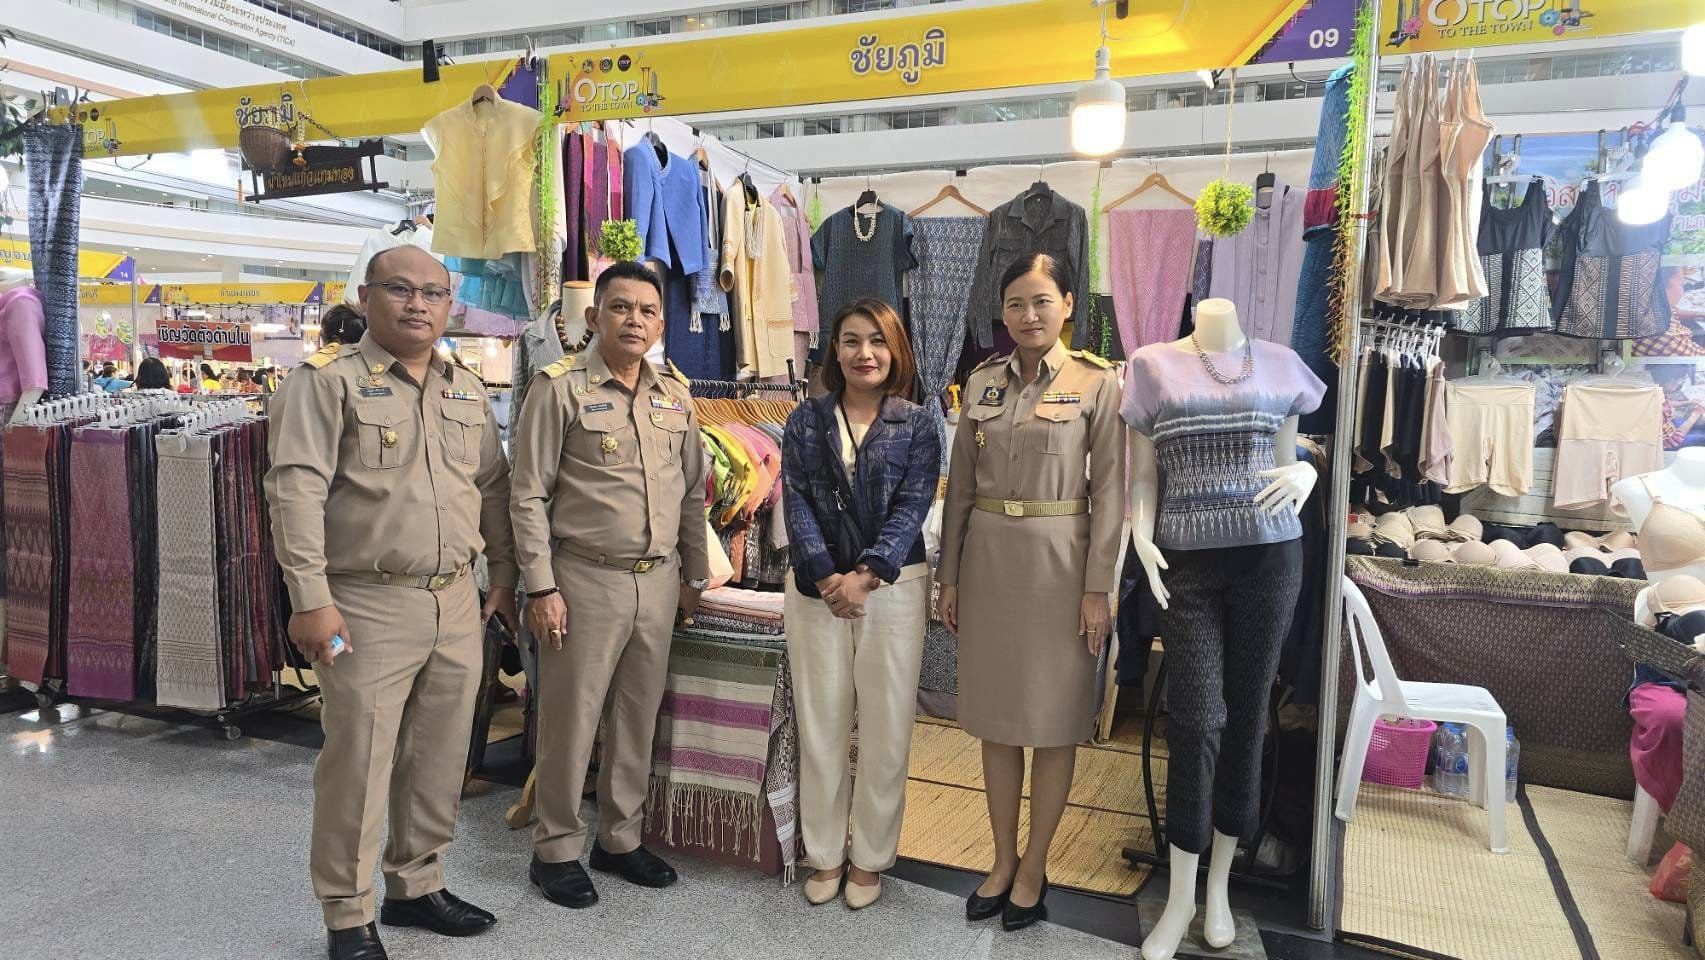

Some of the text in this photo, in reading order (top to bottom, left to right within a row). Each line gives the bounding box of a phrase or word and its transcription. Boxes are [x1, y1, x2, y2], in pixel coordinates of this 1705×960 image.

[1427, 0, 1545, 26] OTOP
[218, 13, 254, 32] Cooperation
[255, 28, 276, 41] Agency
[276, 34, 296, 47] (TICA)
[1308, 28, 1340, 49] 09
[1437, 21, 1534, 39] TO THE TOWN
[850, 28, 945, 83] ชัยภูมิ
[574, 78, 639, 103] OTOP
[581, 101, 633, 112] TO THE TOWN
[158, 324, 251, 346] เชิญวัดตัวด้านใน
